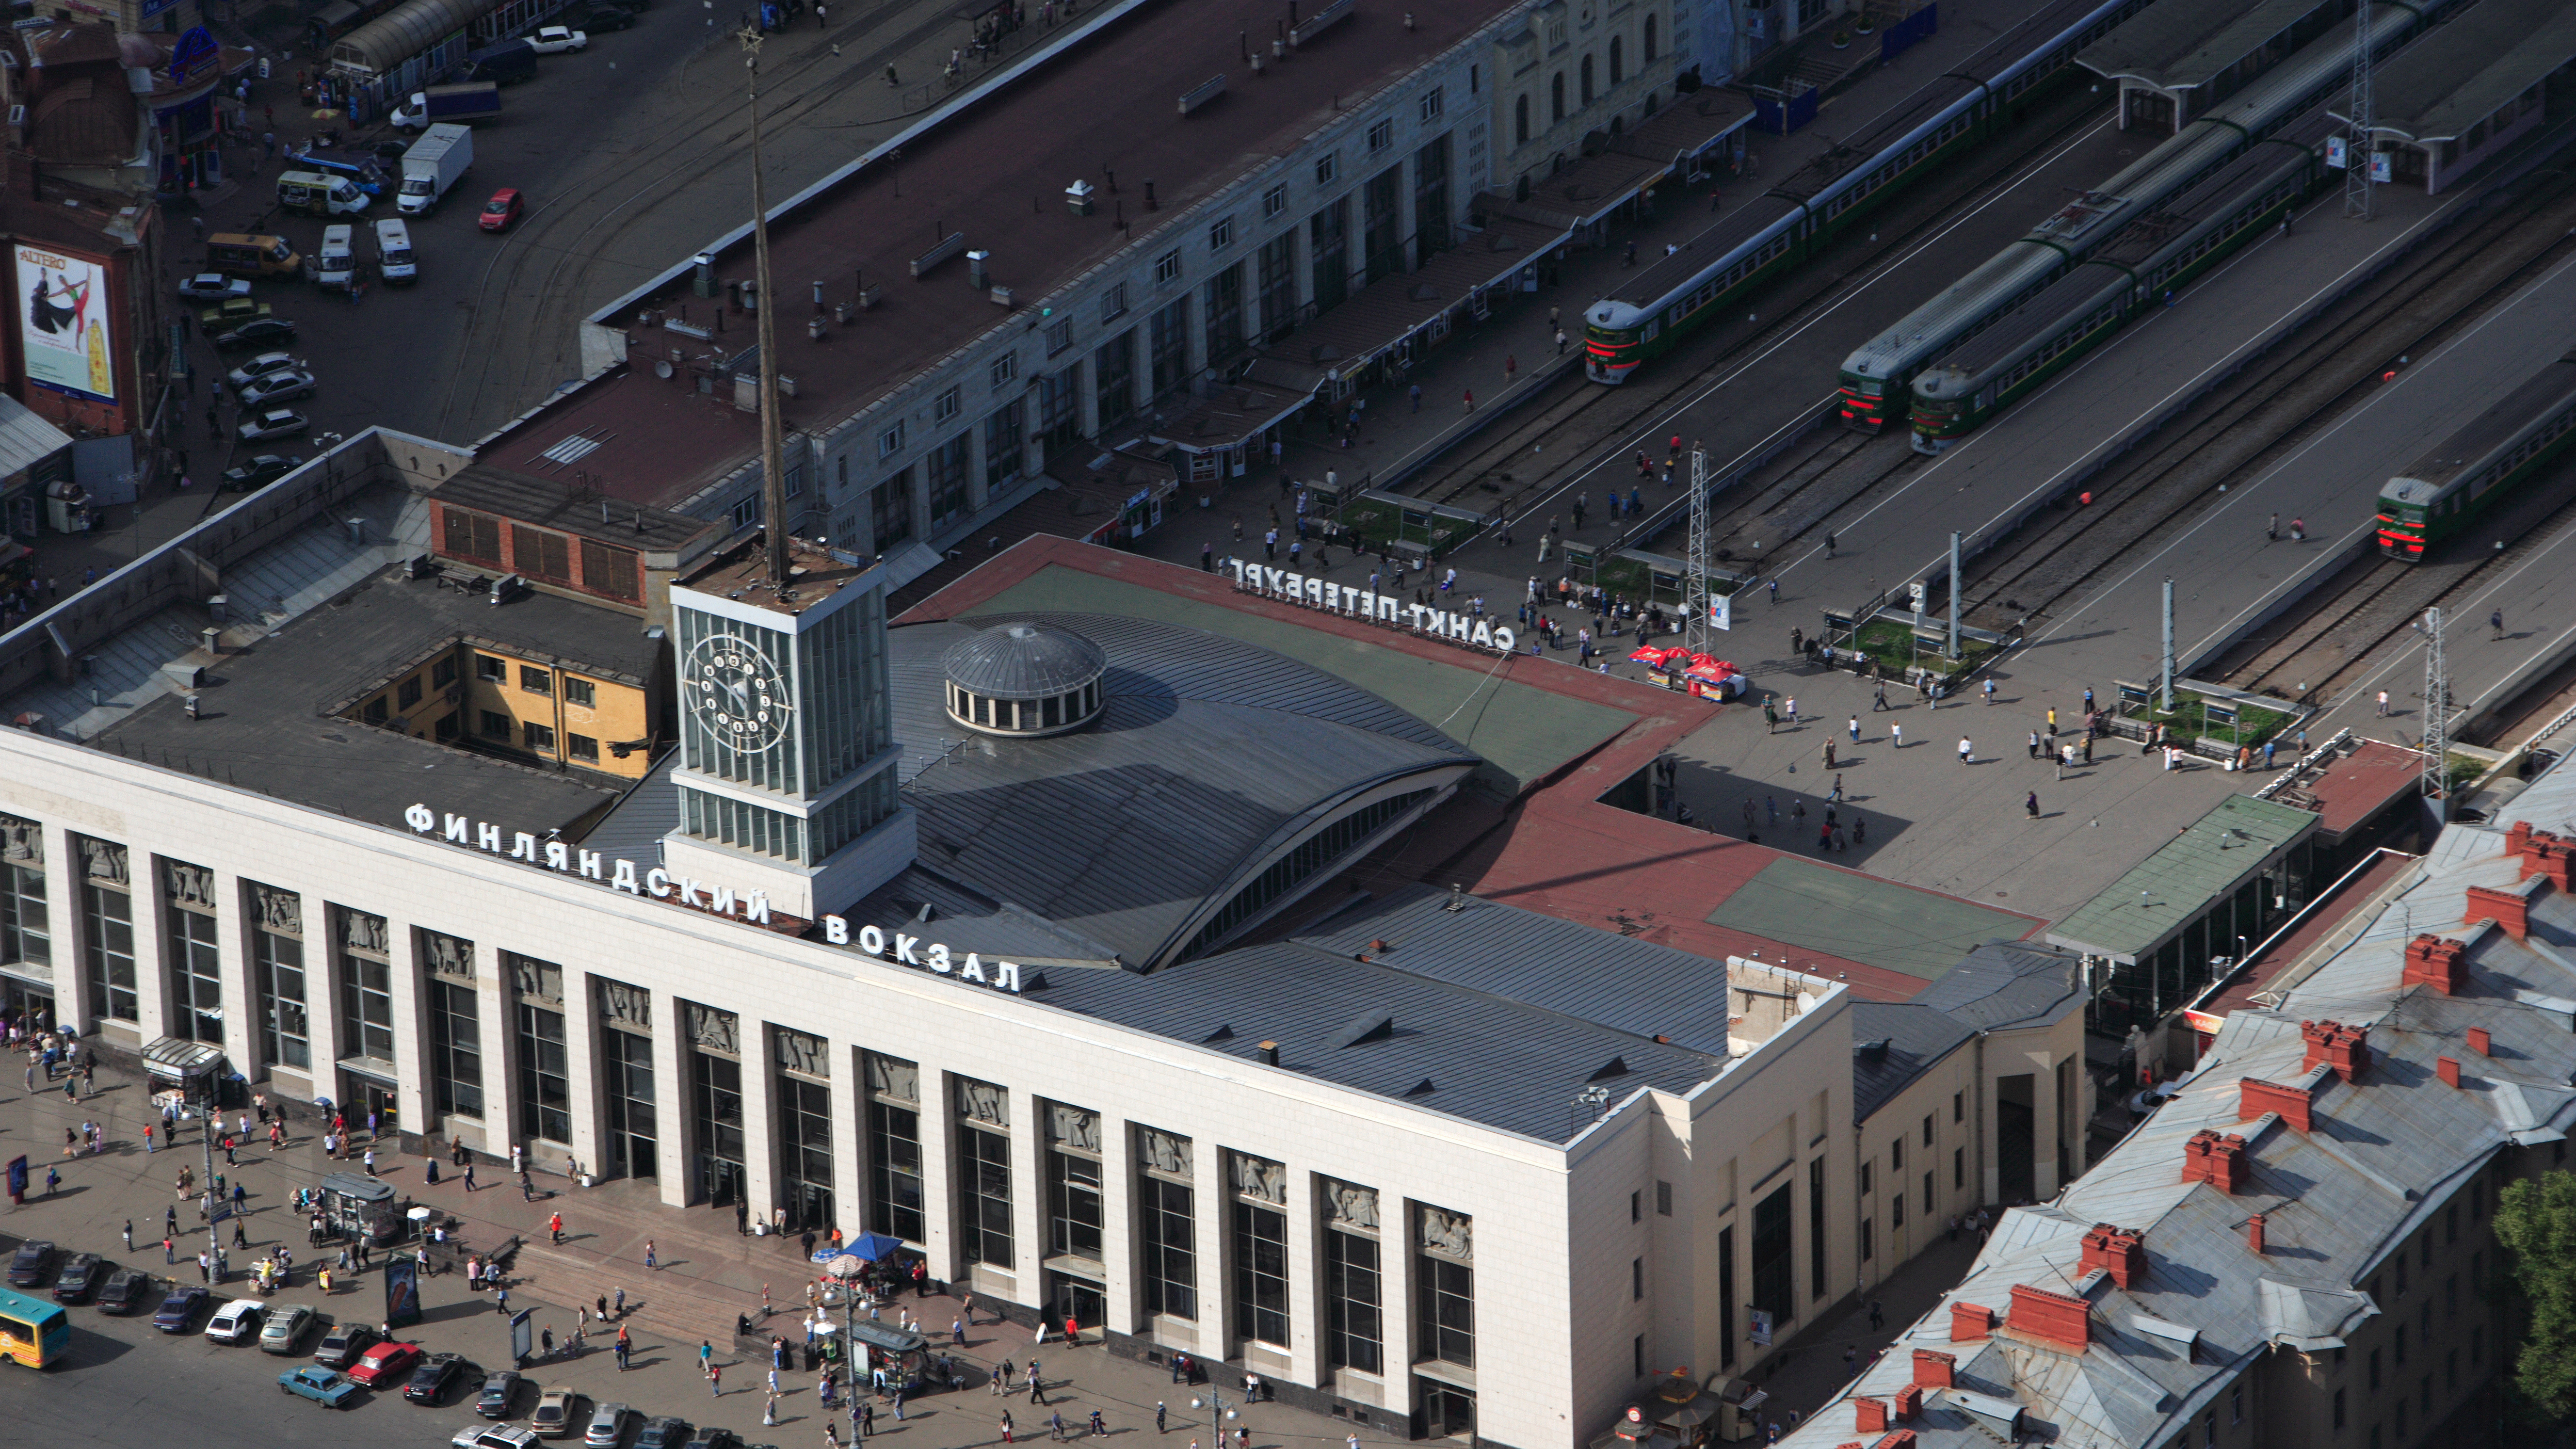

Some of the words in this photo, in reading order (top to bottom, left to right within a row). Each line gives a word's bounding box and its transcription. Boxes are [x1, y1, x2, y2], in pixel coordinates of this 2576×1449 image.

[20, 250, 65, 270] ALTERO
[405, 803, 769, 924] ФИНЛЯНДСКИЙ
[826, 915, 1020, 991] ВОКЗАЛ
